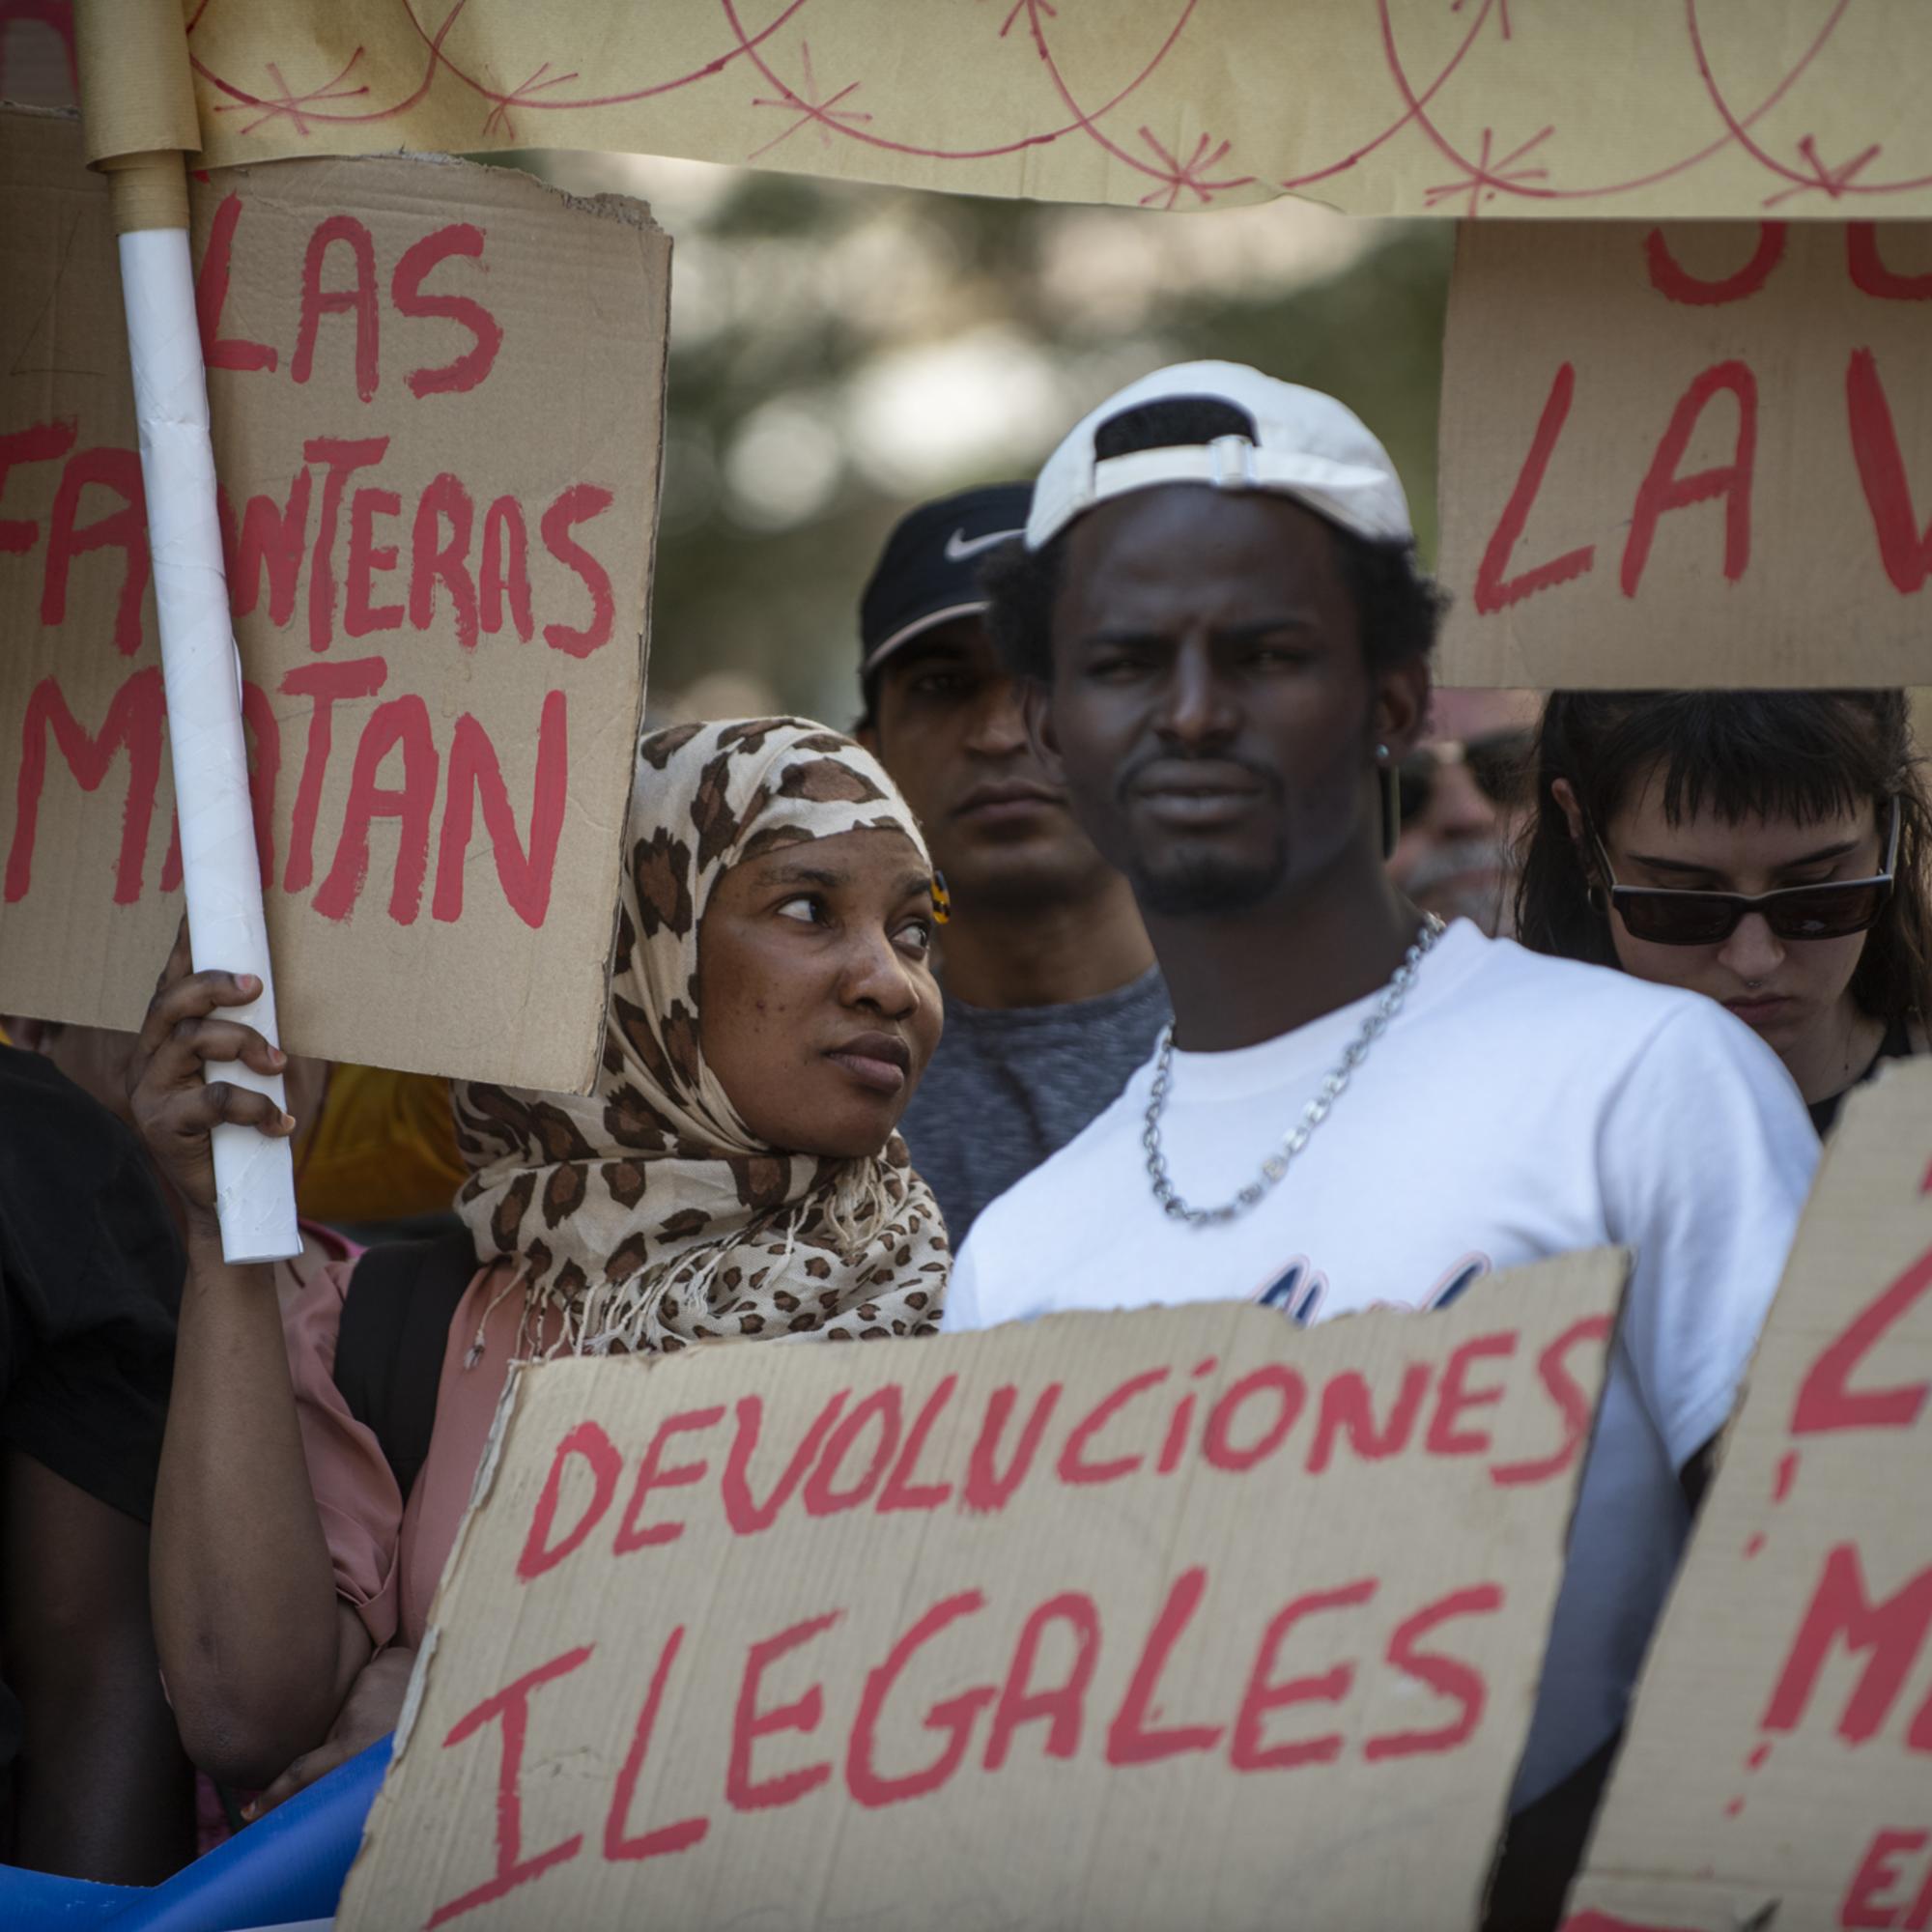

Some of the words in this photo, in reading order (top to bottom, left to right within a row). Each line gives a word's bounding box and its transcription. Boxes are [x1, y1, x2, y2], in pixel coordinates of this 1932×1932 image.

[194, 190, 504, 403] LAS
[0, 414, 615, 659] FRNTERAS
[1473, 359, 1757, 616] LA
[424, 1566, 1504, 1930] ILEGALES
